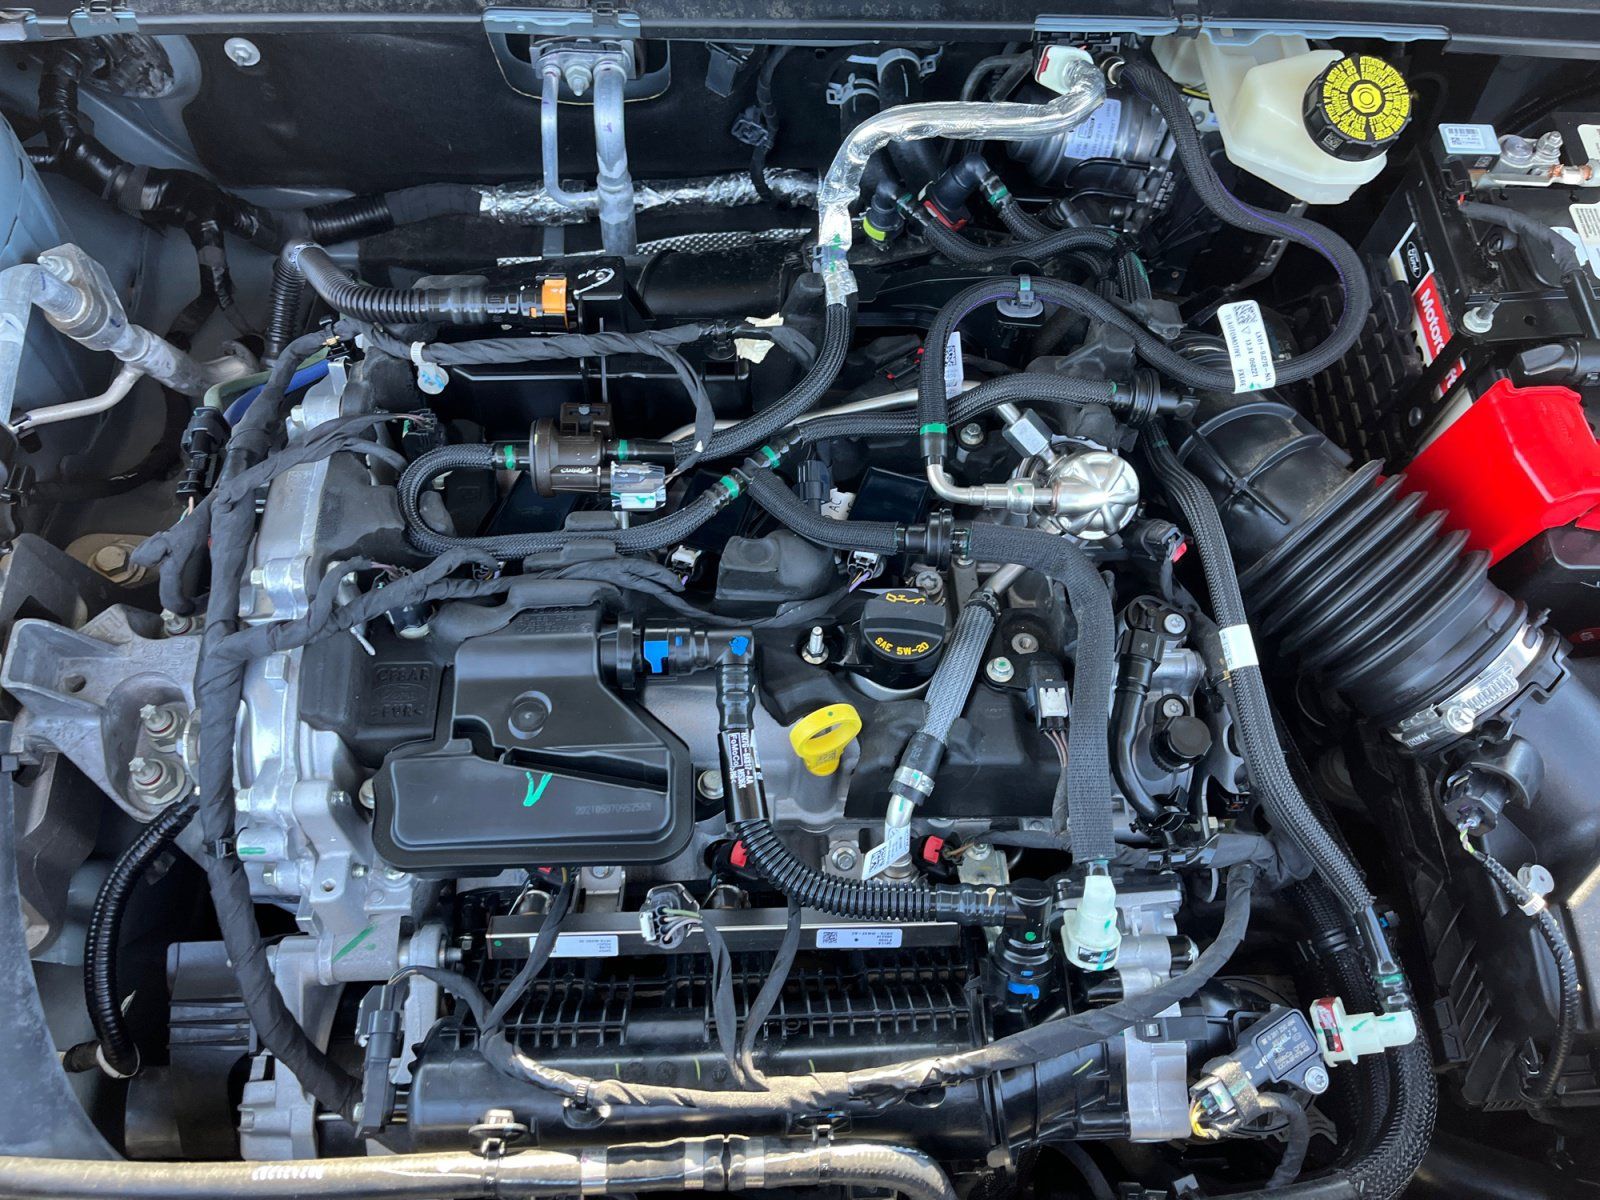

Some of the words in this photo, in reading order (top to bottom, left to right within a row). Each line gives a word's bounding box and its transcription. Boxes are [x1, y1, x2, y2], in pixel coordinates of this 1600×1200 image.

[875, 637, 893, 652] SAE
[897, 642, 929, 655] 5W-20
[730, 734, 740, 766] FoMoCo
